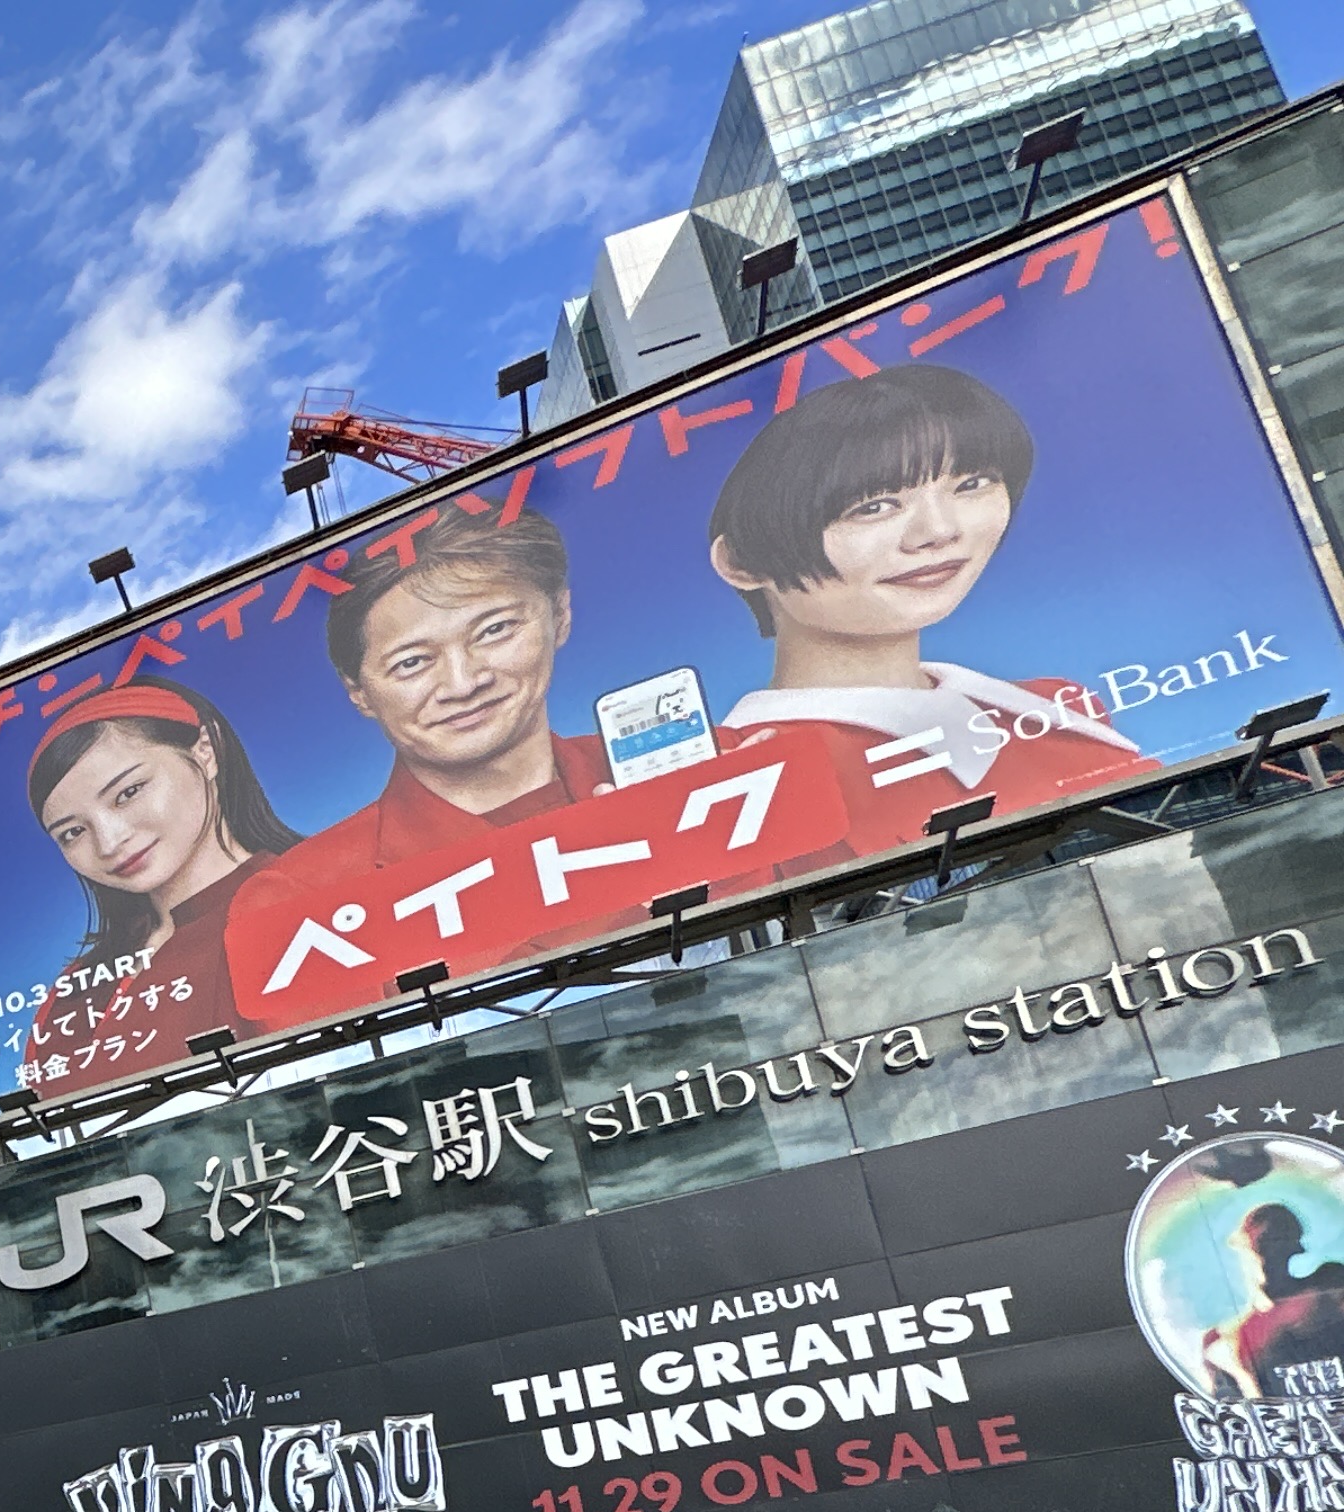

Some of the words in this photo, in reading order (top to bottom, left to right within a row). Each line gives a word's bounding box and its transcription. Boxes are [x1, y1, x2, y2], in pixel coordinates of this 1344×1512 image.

[967, 628, 1291, 759] SoftBank
[261, 761, 785, 995] ペイトク
[54, 947, 155, 998] START
[15, 1028, 158, 1088] 料金プラン
[583, 1024, 936, 1144] shibuya
[965, 928, 1326, 1052] station
[194, 1076, 553, 1242] 渋谷駅
[492, 1362, 623, 1424] THE
[639, 1285, 1014, 1400] GREATEST
[620, 1306, 699, 1342] NEW
[710, 1277, 840, 1326] ALBUM
[541, 1358, 970, 1470] UNKNOWN
[700, 1446, 821, 1507] ON
[835, 1415, 1029, 1489] SALE
